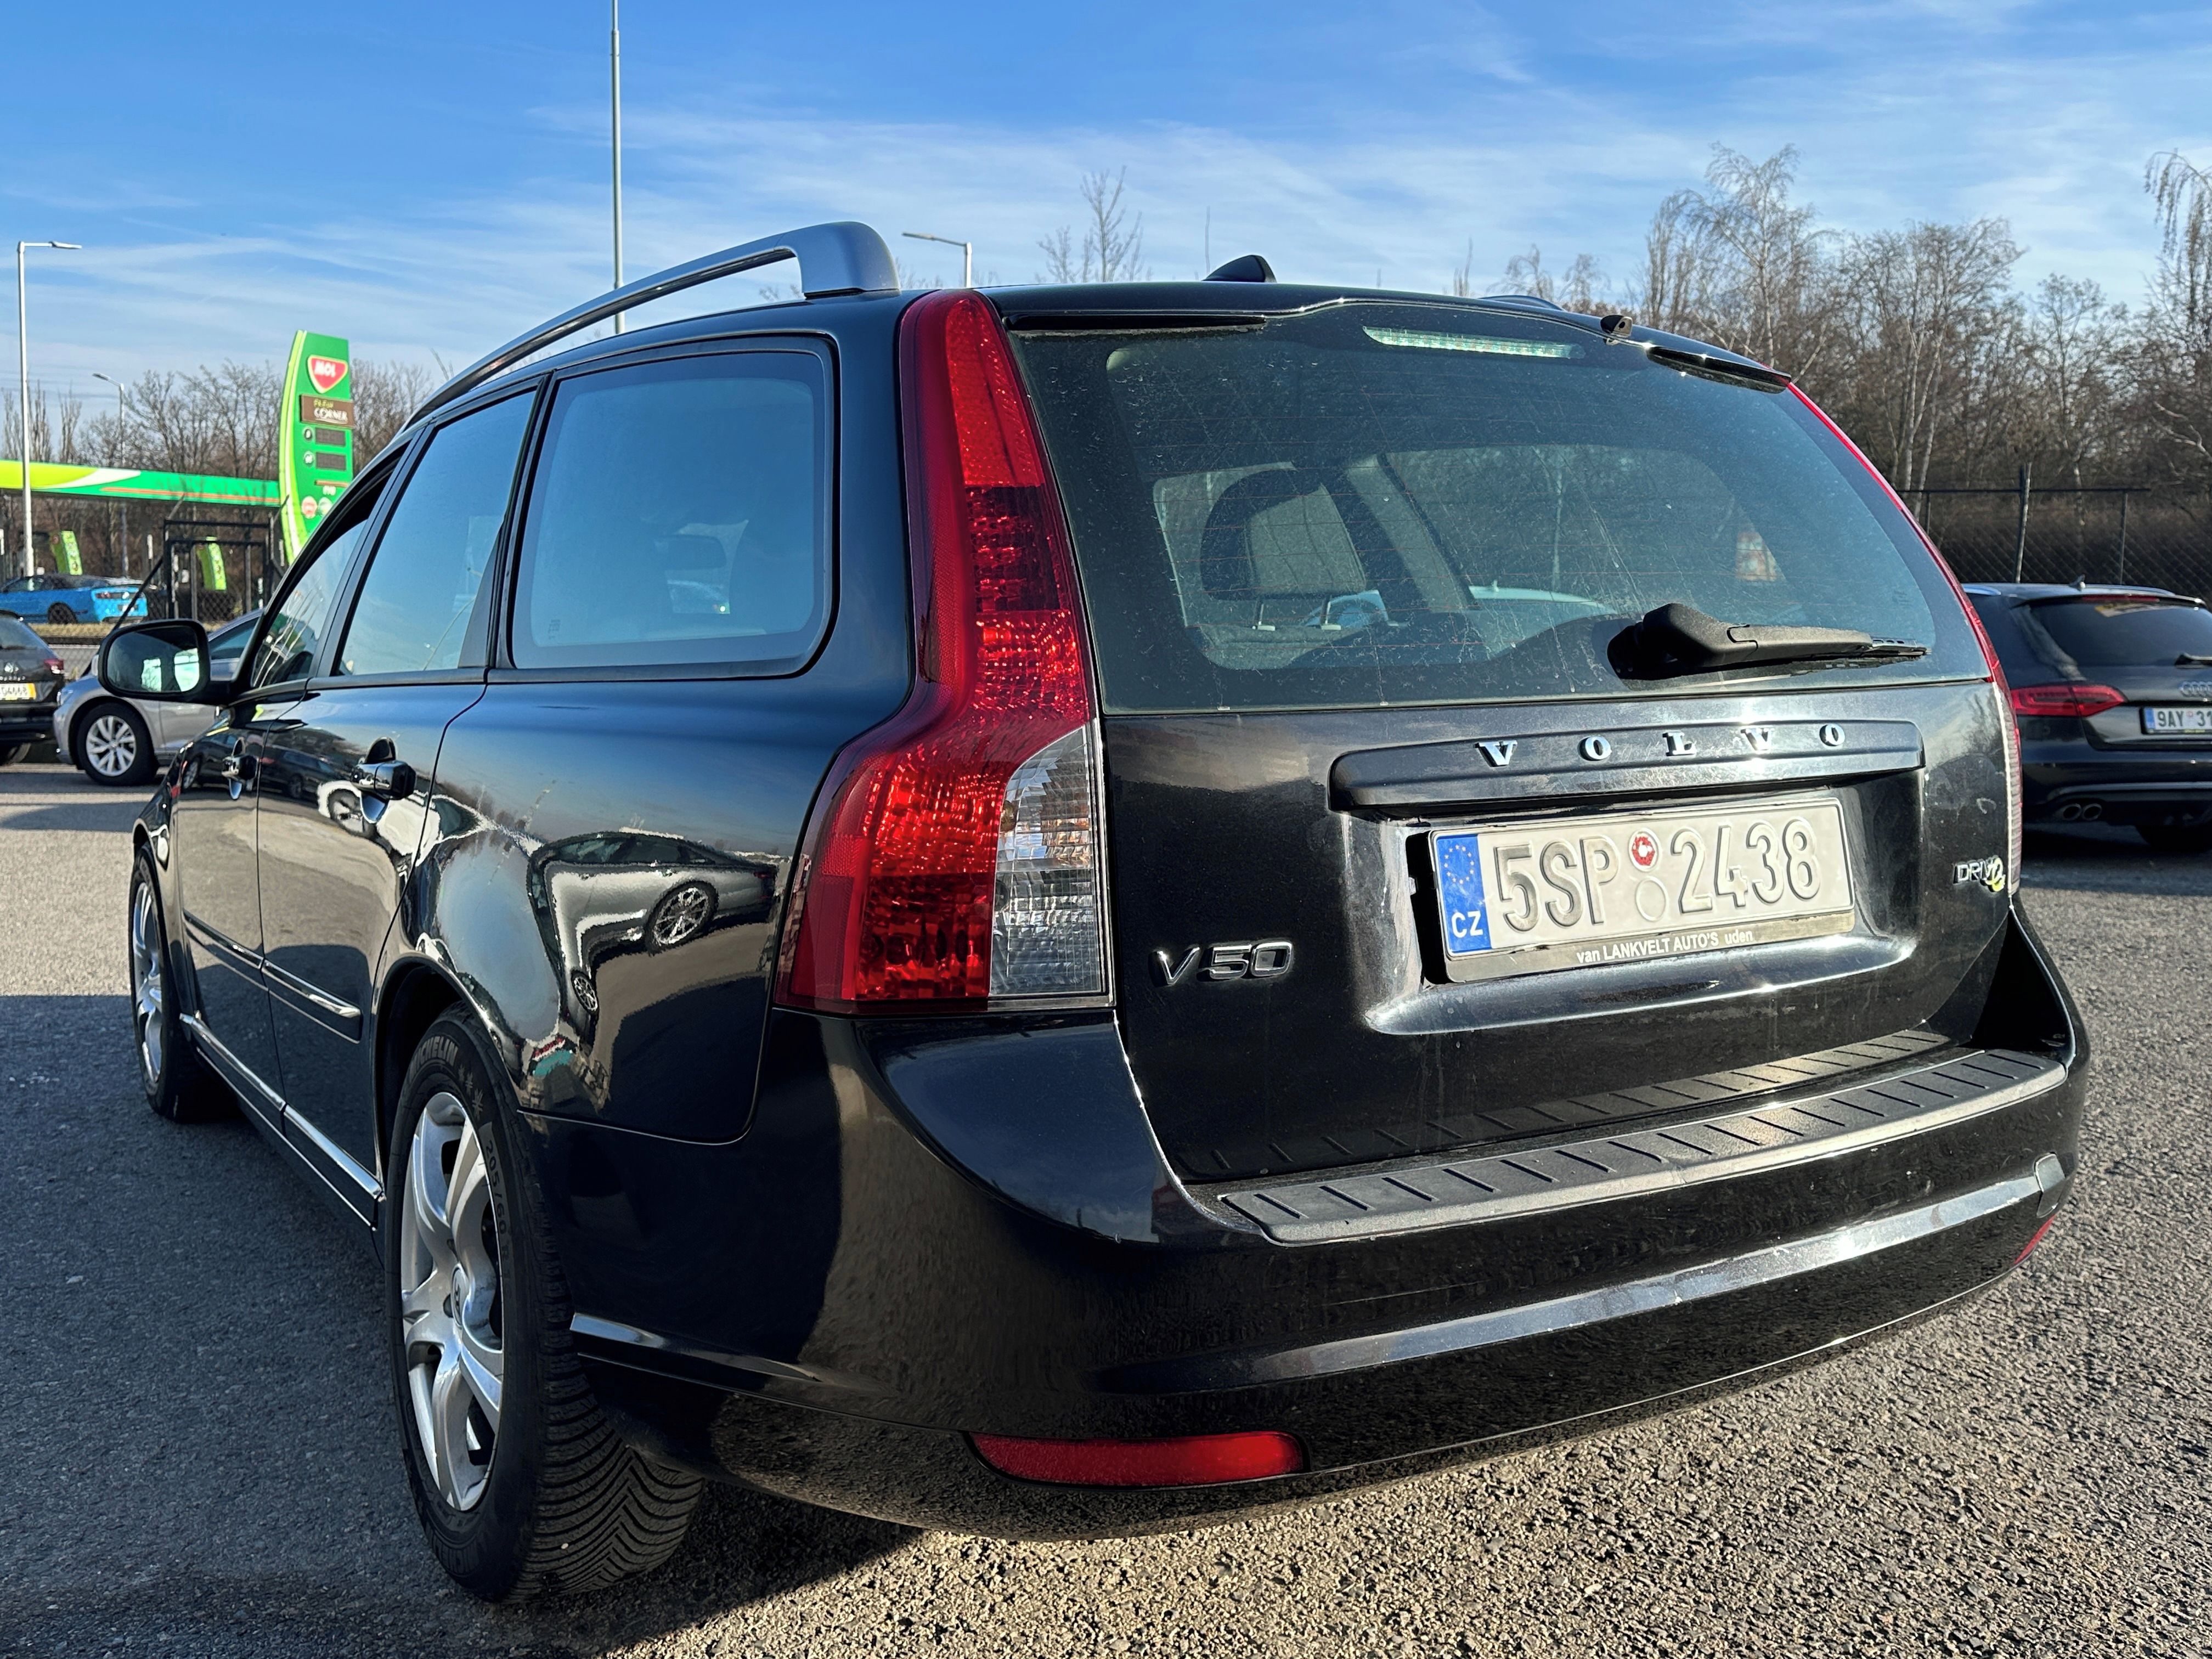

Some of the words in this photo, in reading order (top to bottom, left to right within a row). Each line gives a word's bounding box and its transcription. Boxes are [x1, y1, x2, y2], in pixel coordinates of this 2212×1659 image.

[314, 360, 336, 377] MOL
[2157, 710, 2184, 727] 9AY
[1475, 724, 1845, 766] VOLVO
[1493, 836, 1618, 932] 5SP
[1671, 817, 1821, 913] 2438
[1451, 910, 1483, 938] CZ
[1151, 941, 1293, 986] V50
[1576, 950, 1601, 963] van
[1603, 938, 1670, 961] LANKVELT
[1673, 932, 1719, 952] AUTO'S
[1724, 929, 1753, 945] uden
[486, 1139, 507, 1235] 205/60
